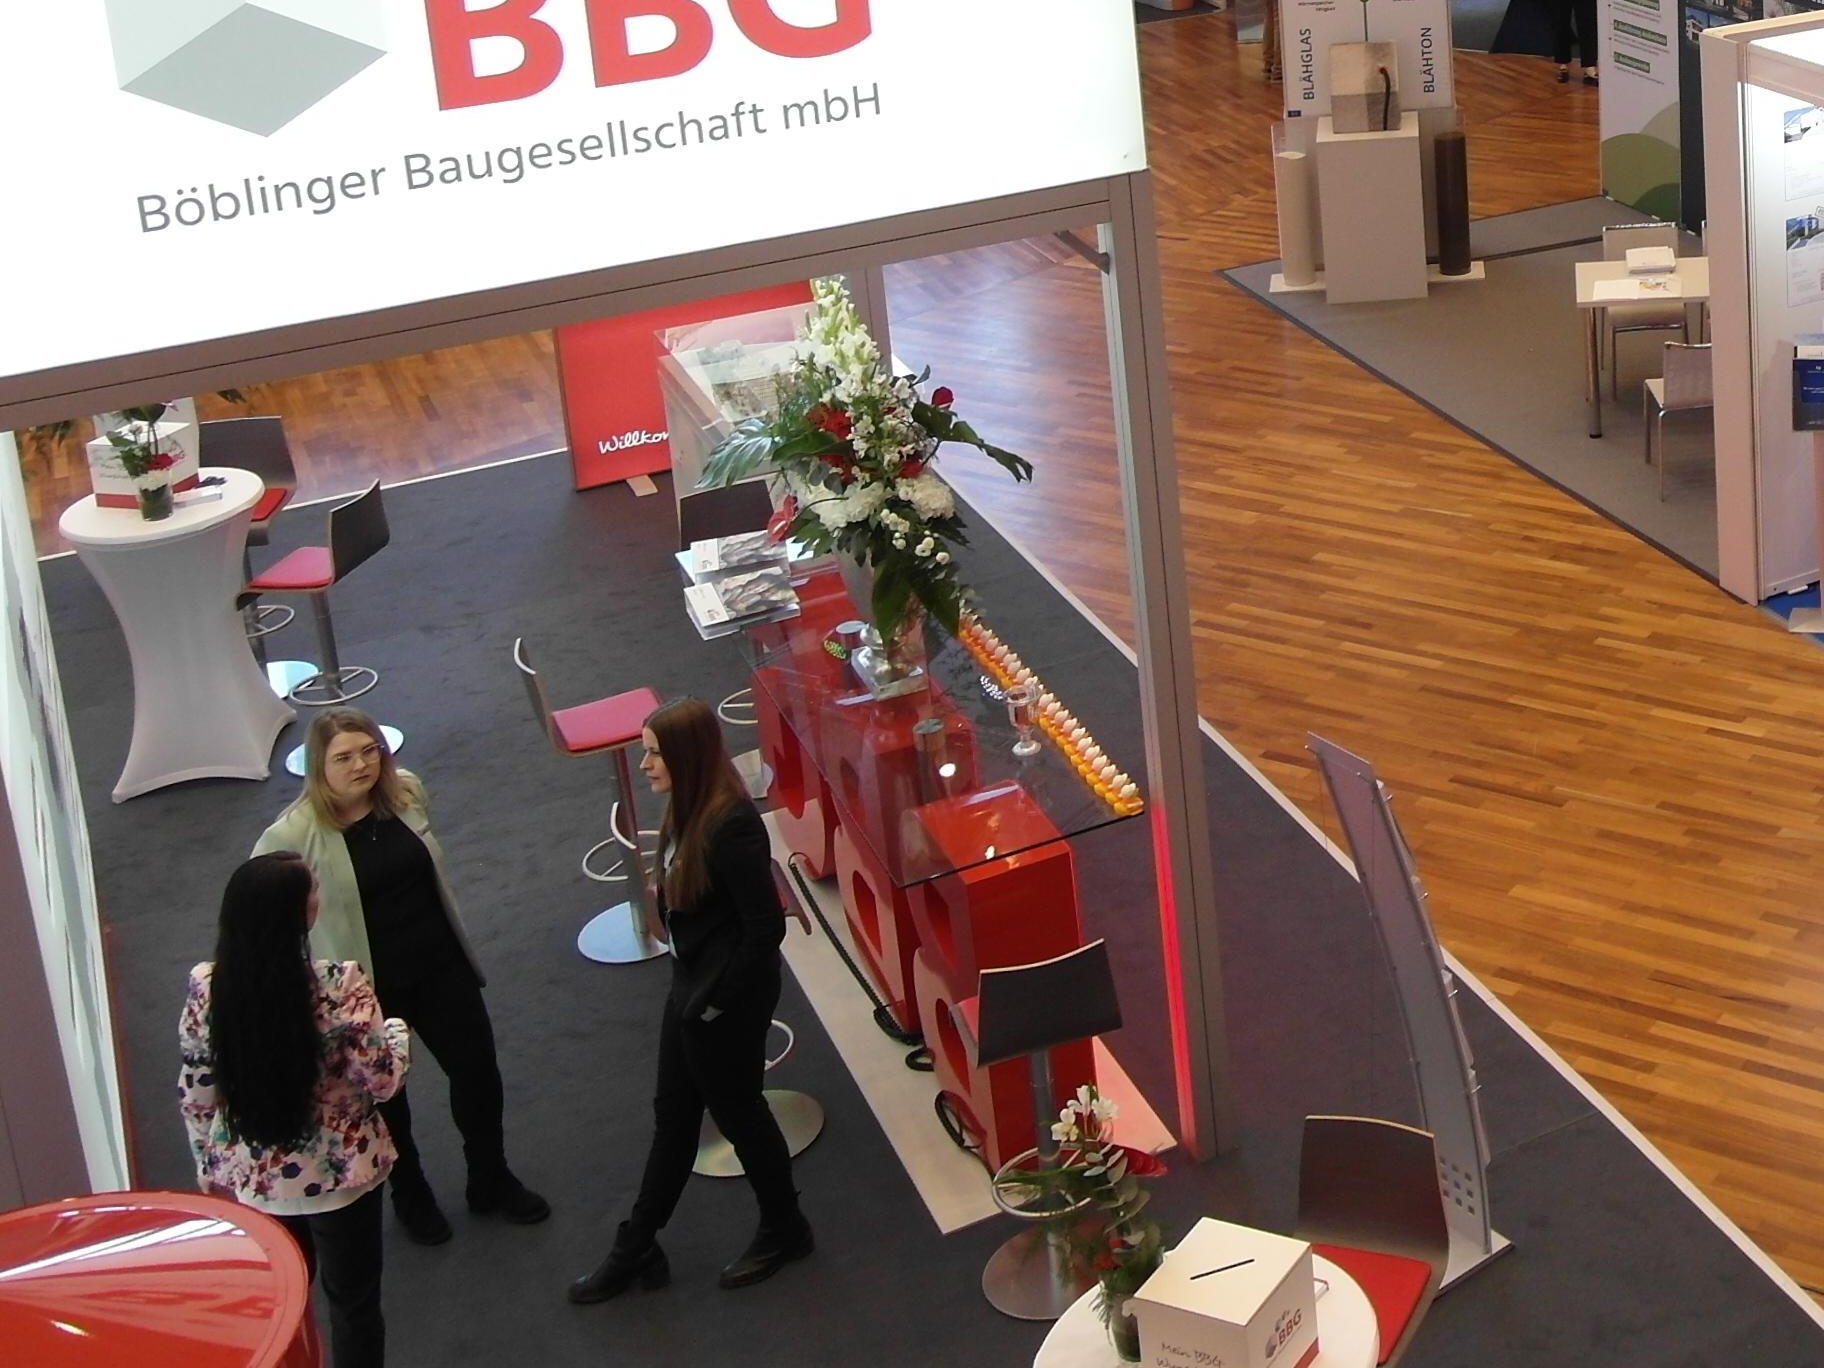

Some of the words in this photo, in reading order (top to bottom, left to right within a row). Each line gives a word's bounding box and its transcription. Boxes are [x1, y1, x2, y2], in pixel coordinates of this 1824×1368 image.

[1299, 28, 1315, 100] BLÄHGLAS
[1420, 27, 1435, 93] BLÄHTON
[136, 156, 386, 234] Böblinger
[403, 99, 767, 191] Baugesellschaft
[780, 81, 884, 133] mbH
[1161, 1341, 1191, 1359] Mein
[1277, 1308, 1302, 1347] BBG
